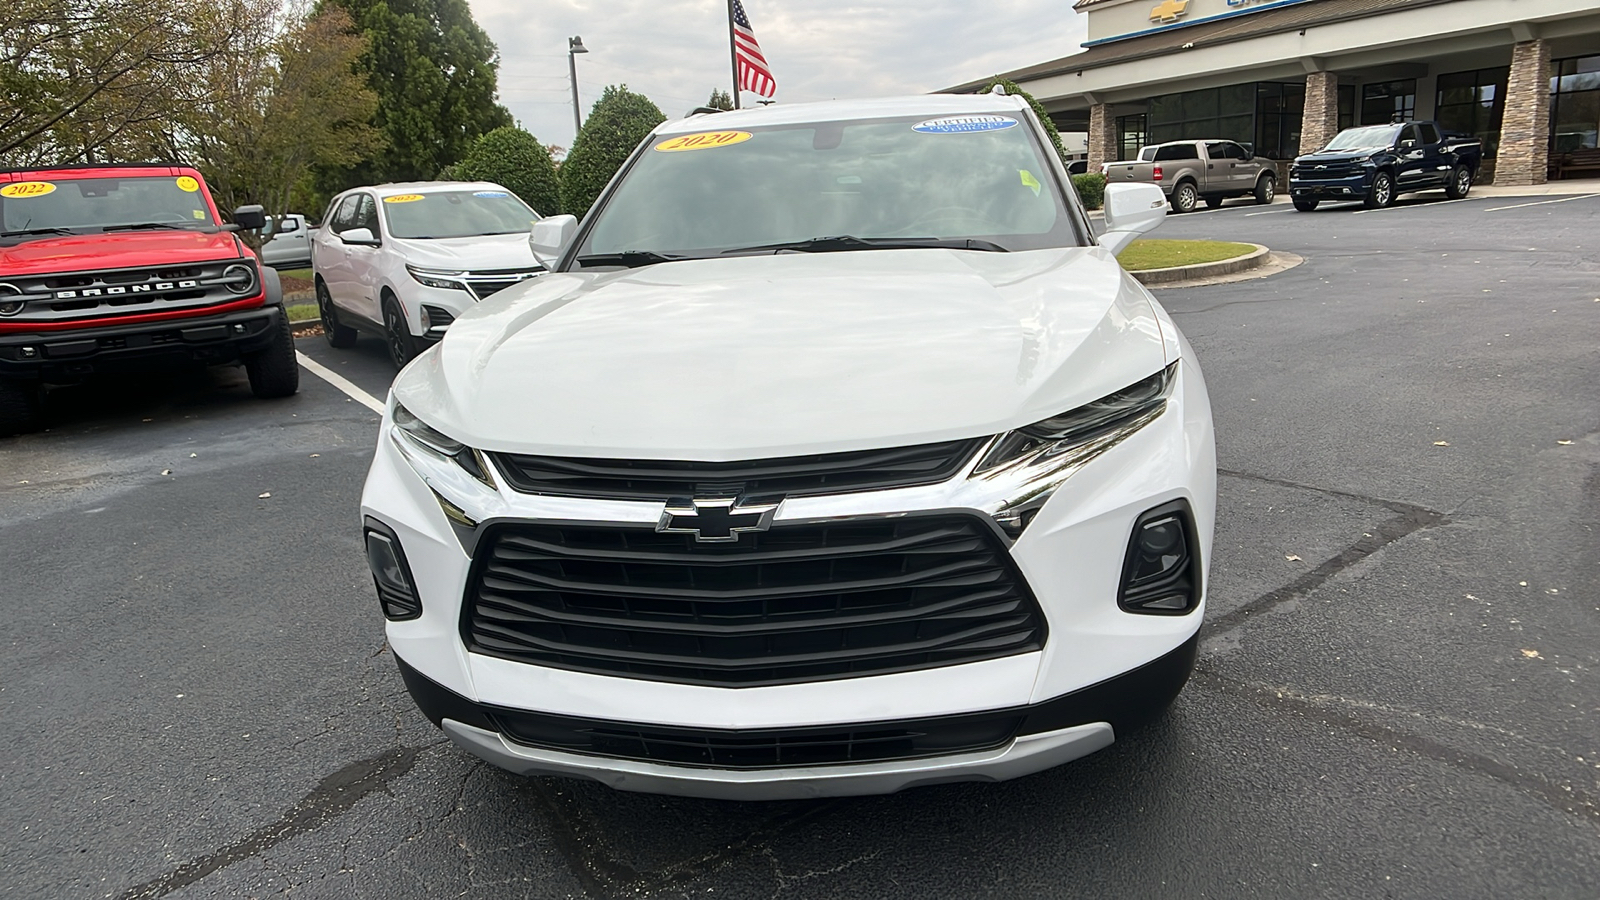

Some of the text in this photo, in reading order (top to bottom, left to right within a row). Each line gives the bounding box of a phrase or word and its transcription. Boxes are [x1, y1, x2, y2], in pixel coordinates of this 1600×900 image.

[922, 116, 1005, 127] CERTIFIED
[667, 132, 738, 149] 2020
[9, 183, 46, 195] 2022
[57, 280, 197, 299] BRONCO
